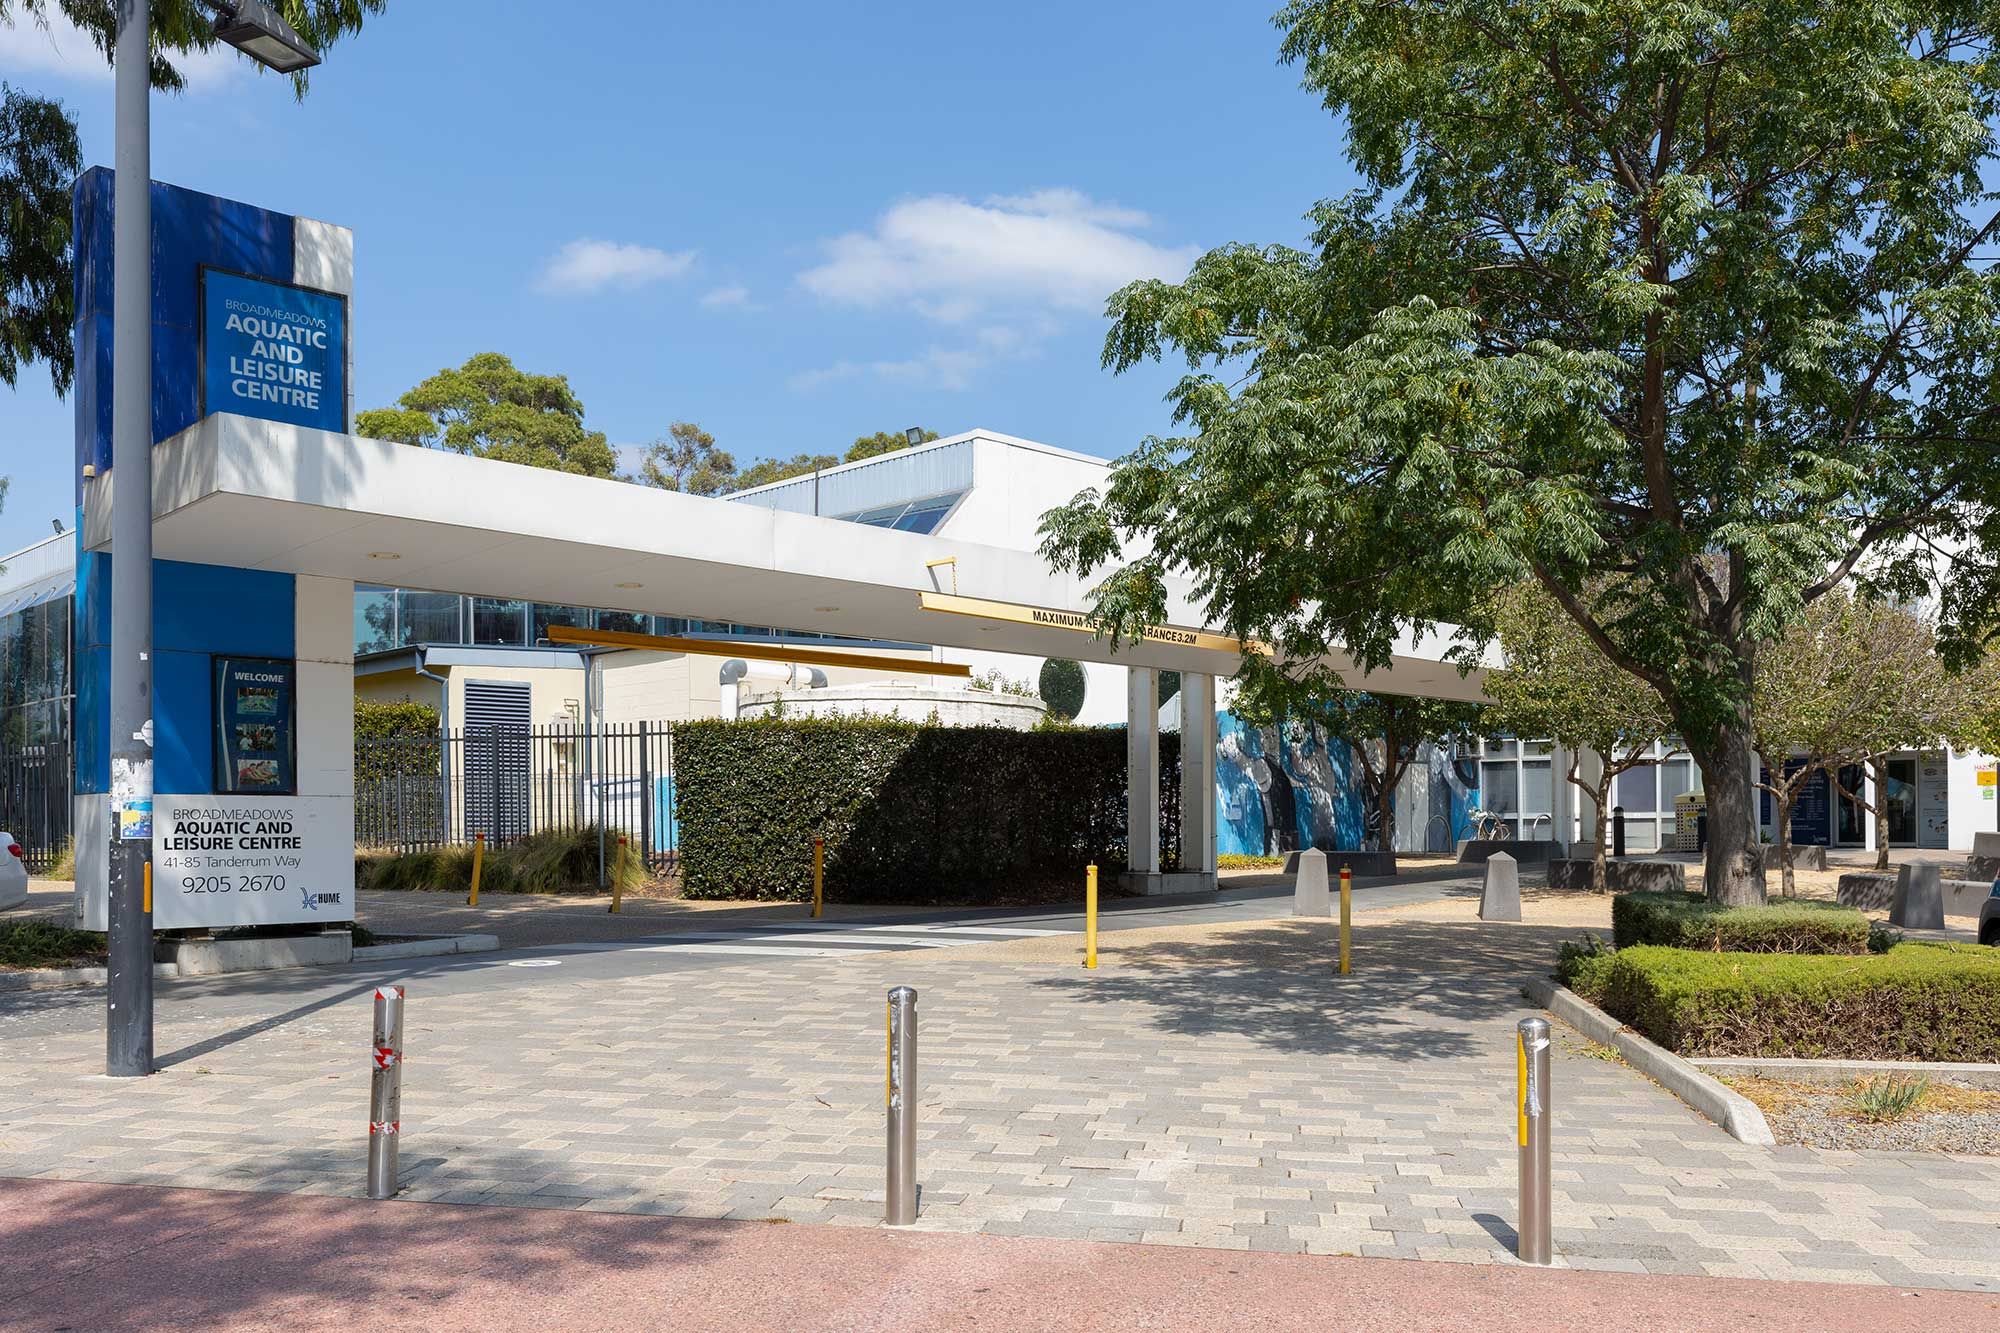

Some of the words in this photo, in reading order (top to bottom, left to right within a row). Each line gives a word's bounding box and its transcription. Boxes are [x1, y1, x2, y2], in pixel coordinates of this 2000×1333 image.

[225, 299, 327, 329] BROADMEADOWS
[225, 313, 327, 350] AQUATIC
[251, 340, 304, 365] AND
[230, 356, 322, 390] LEISURE
[231, 378, 320, 410] CENTRE
[1032, 610, 1083, 627] MAXIMUM
[234, 671, 285, 683] WELCOME
[173, 808, 294, 820] BROADMEADOWS
[174, 821, 250, 836] AQUATIC
[255, 822, 293, 835] AND
[163, 837, 233, 851] LEISURE
[238, 836, 301, 850] CENTRE
[163, 856, 201, 868] 41-85
[205, 855, 271, 868] Tanderrum
[274, 855, 302, 869] Way
[182, 876, 232, 894] 9205
[238, 875, 286, 892] 2670
[317, 893, 341, 904] HUME
